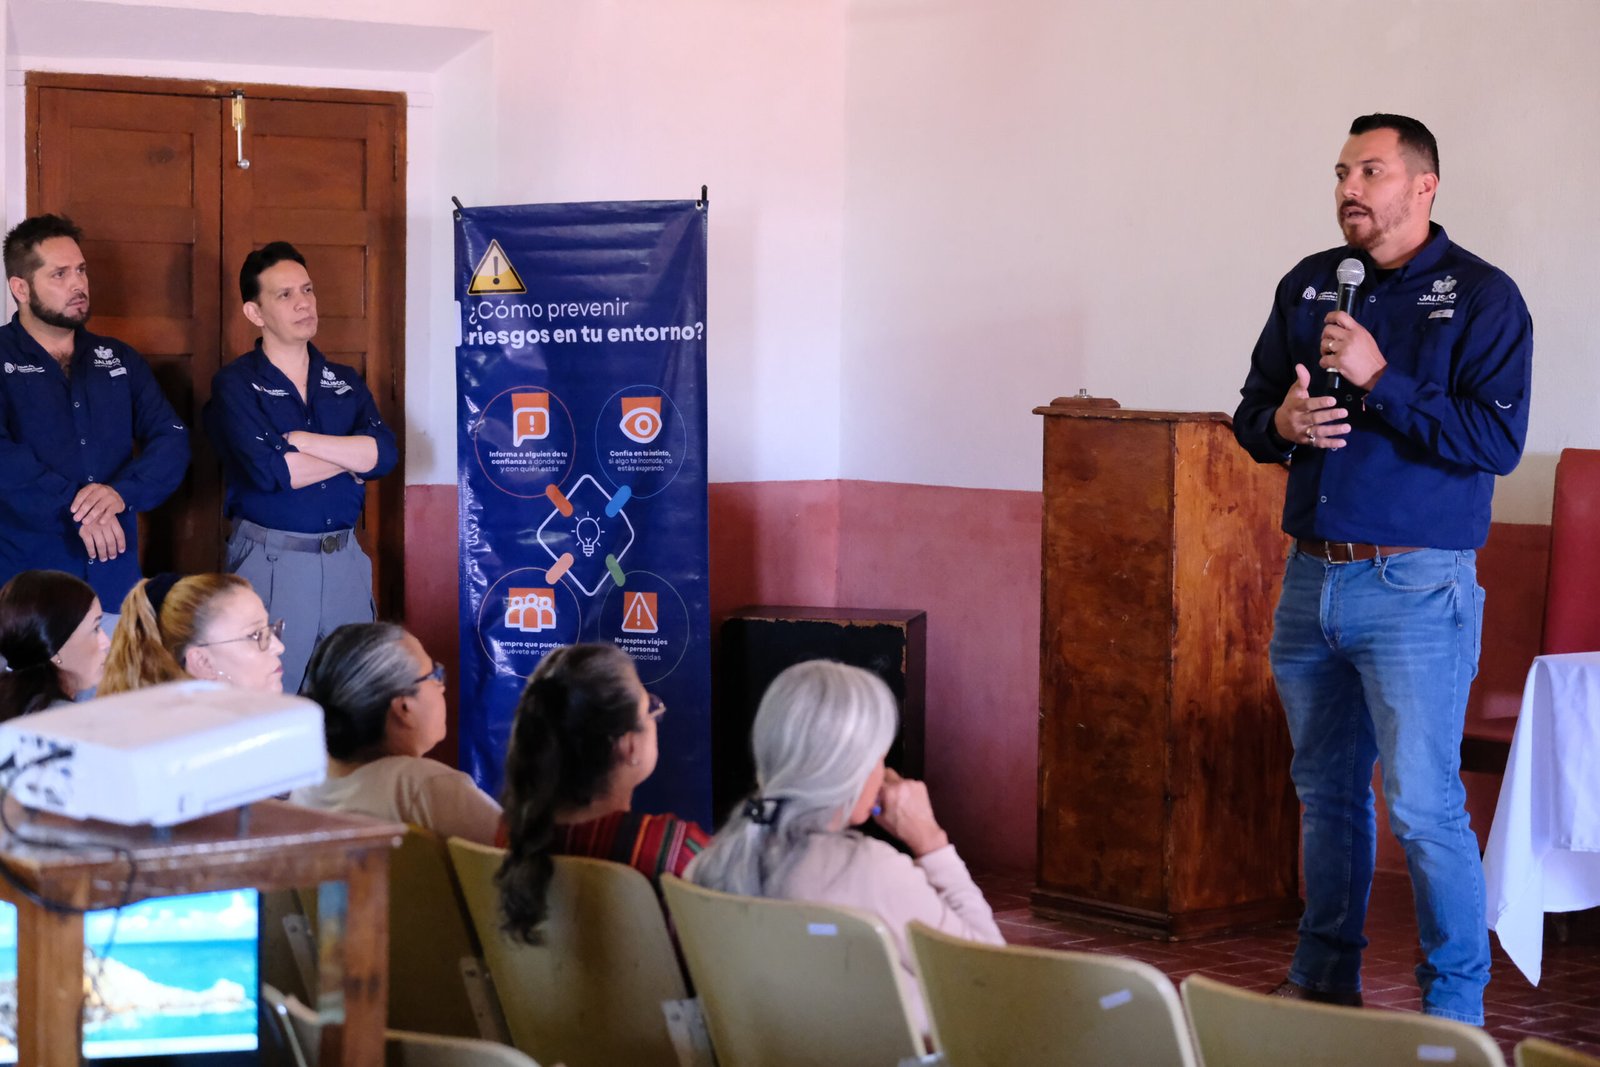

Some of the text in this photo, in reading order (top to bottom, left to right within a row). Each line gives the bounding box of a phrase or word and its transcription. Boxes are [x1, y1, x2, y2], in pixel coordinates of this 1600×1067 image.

[1418, 292, 1457, 302] JALISO
[468, 298, 630, 324] ¿Cómo prevenir
[468, 322, 704, 350] riesgos en tu entorno?
[525, 451, 551, 459] alguien
[648, 638, 668, 646] viajes
